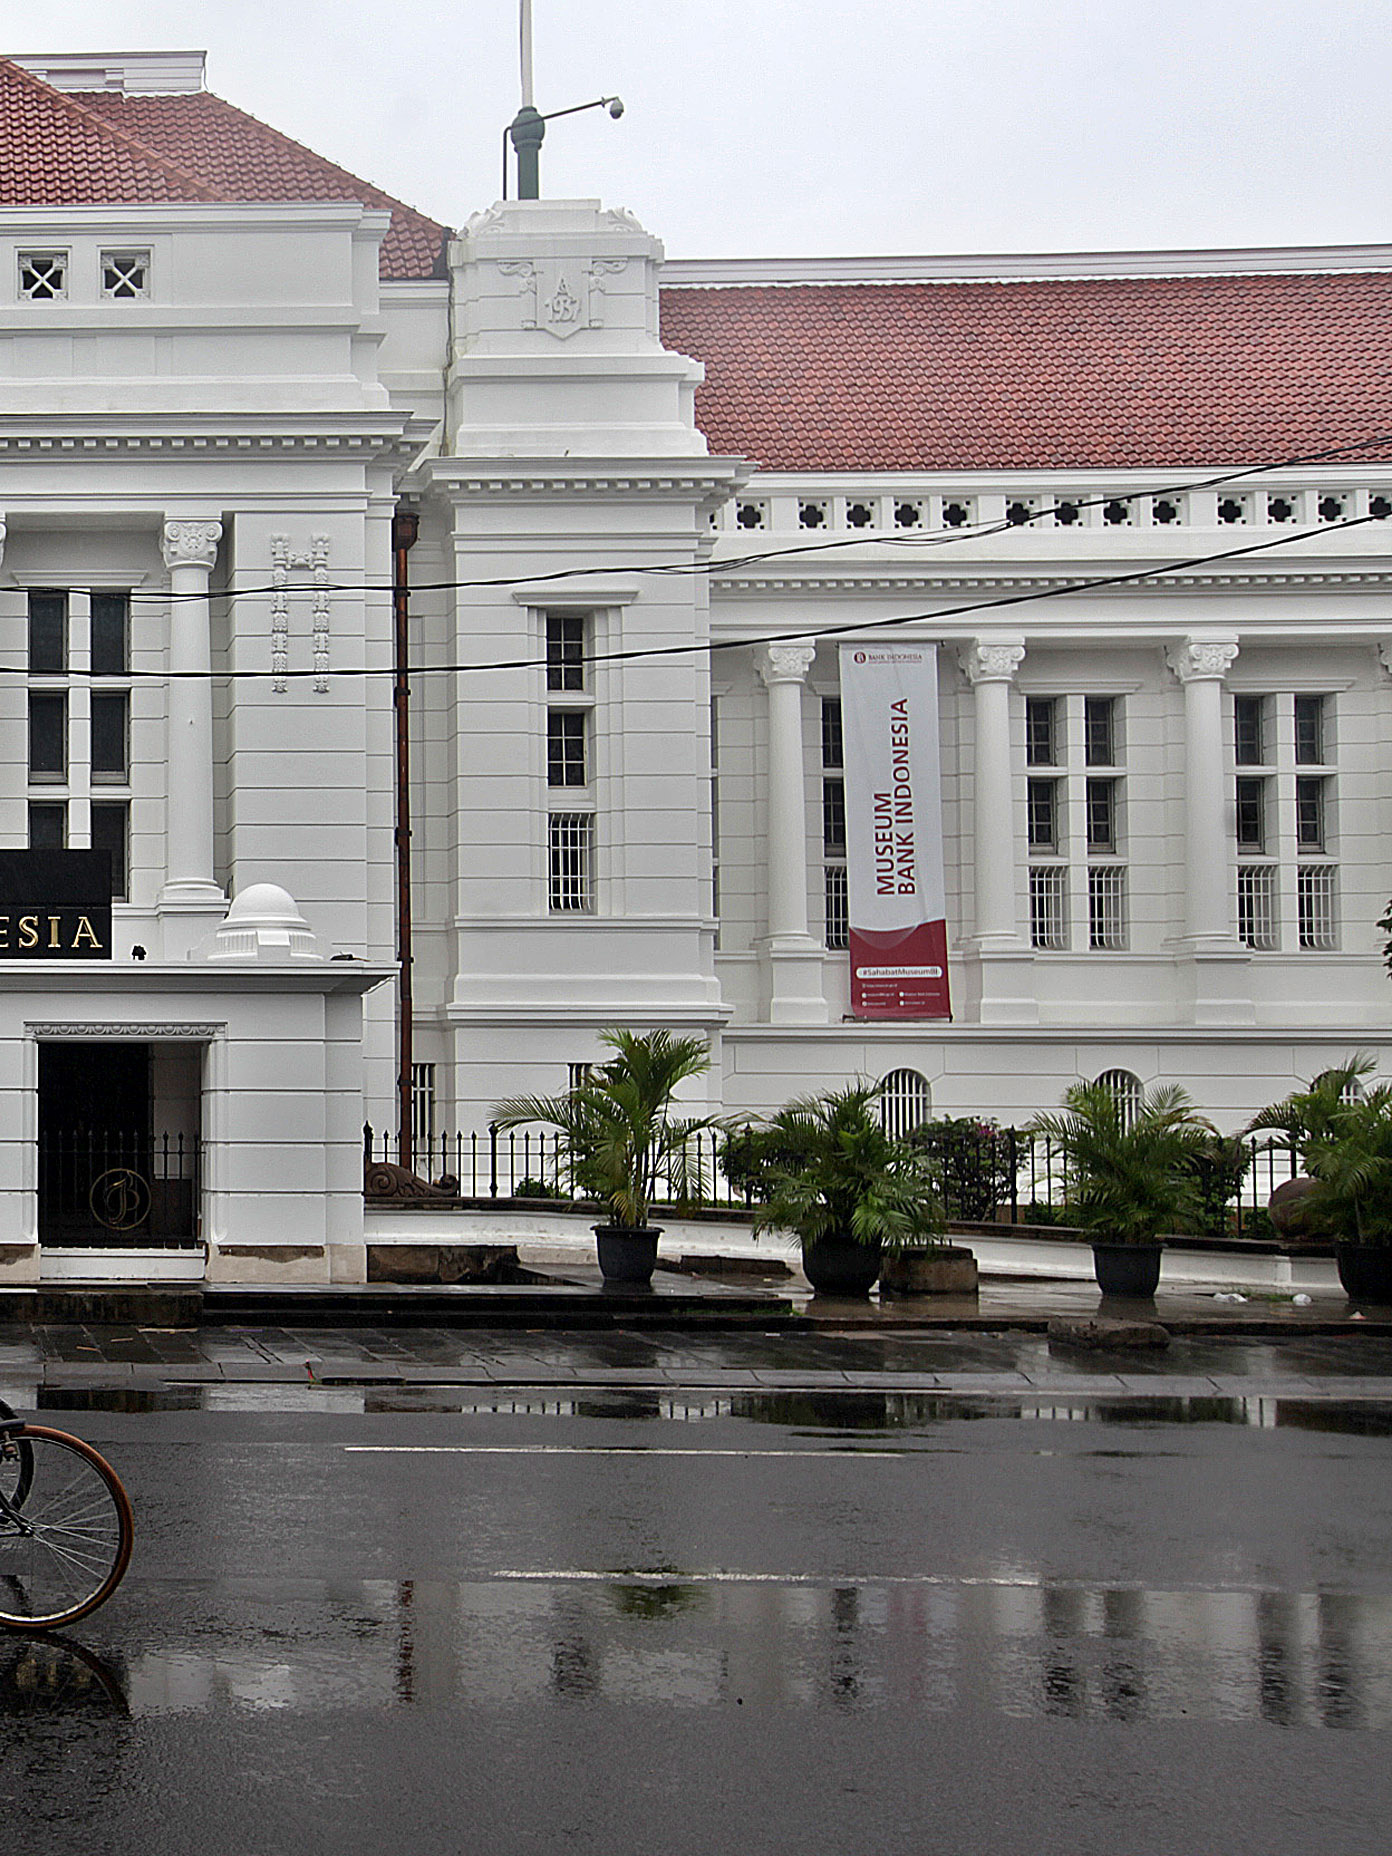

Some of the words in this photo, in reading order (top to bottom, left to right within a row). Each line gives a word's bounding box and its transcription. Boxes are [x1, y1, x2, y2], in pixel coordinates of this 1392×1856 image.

[543, 299, 582, 323] 1937
[890, 698, 914, 824] INDONESIA
[873, 792, 896, 896] MUSEUM
[897, 831, 916, 896] BANK
